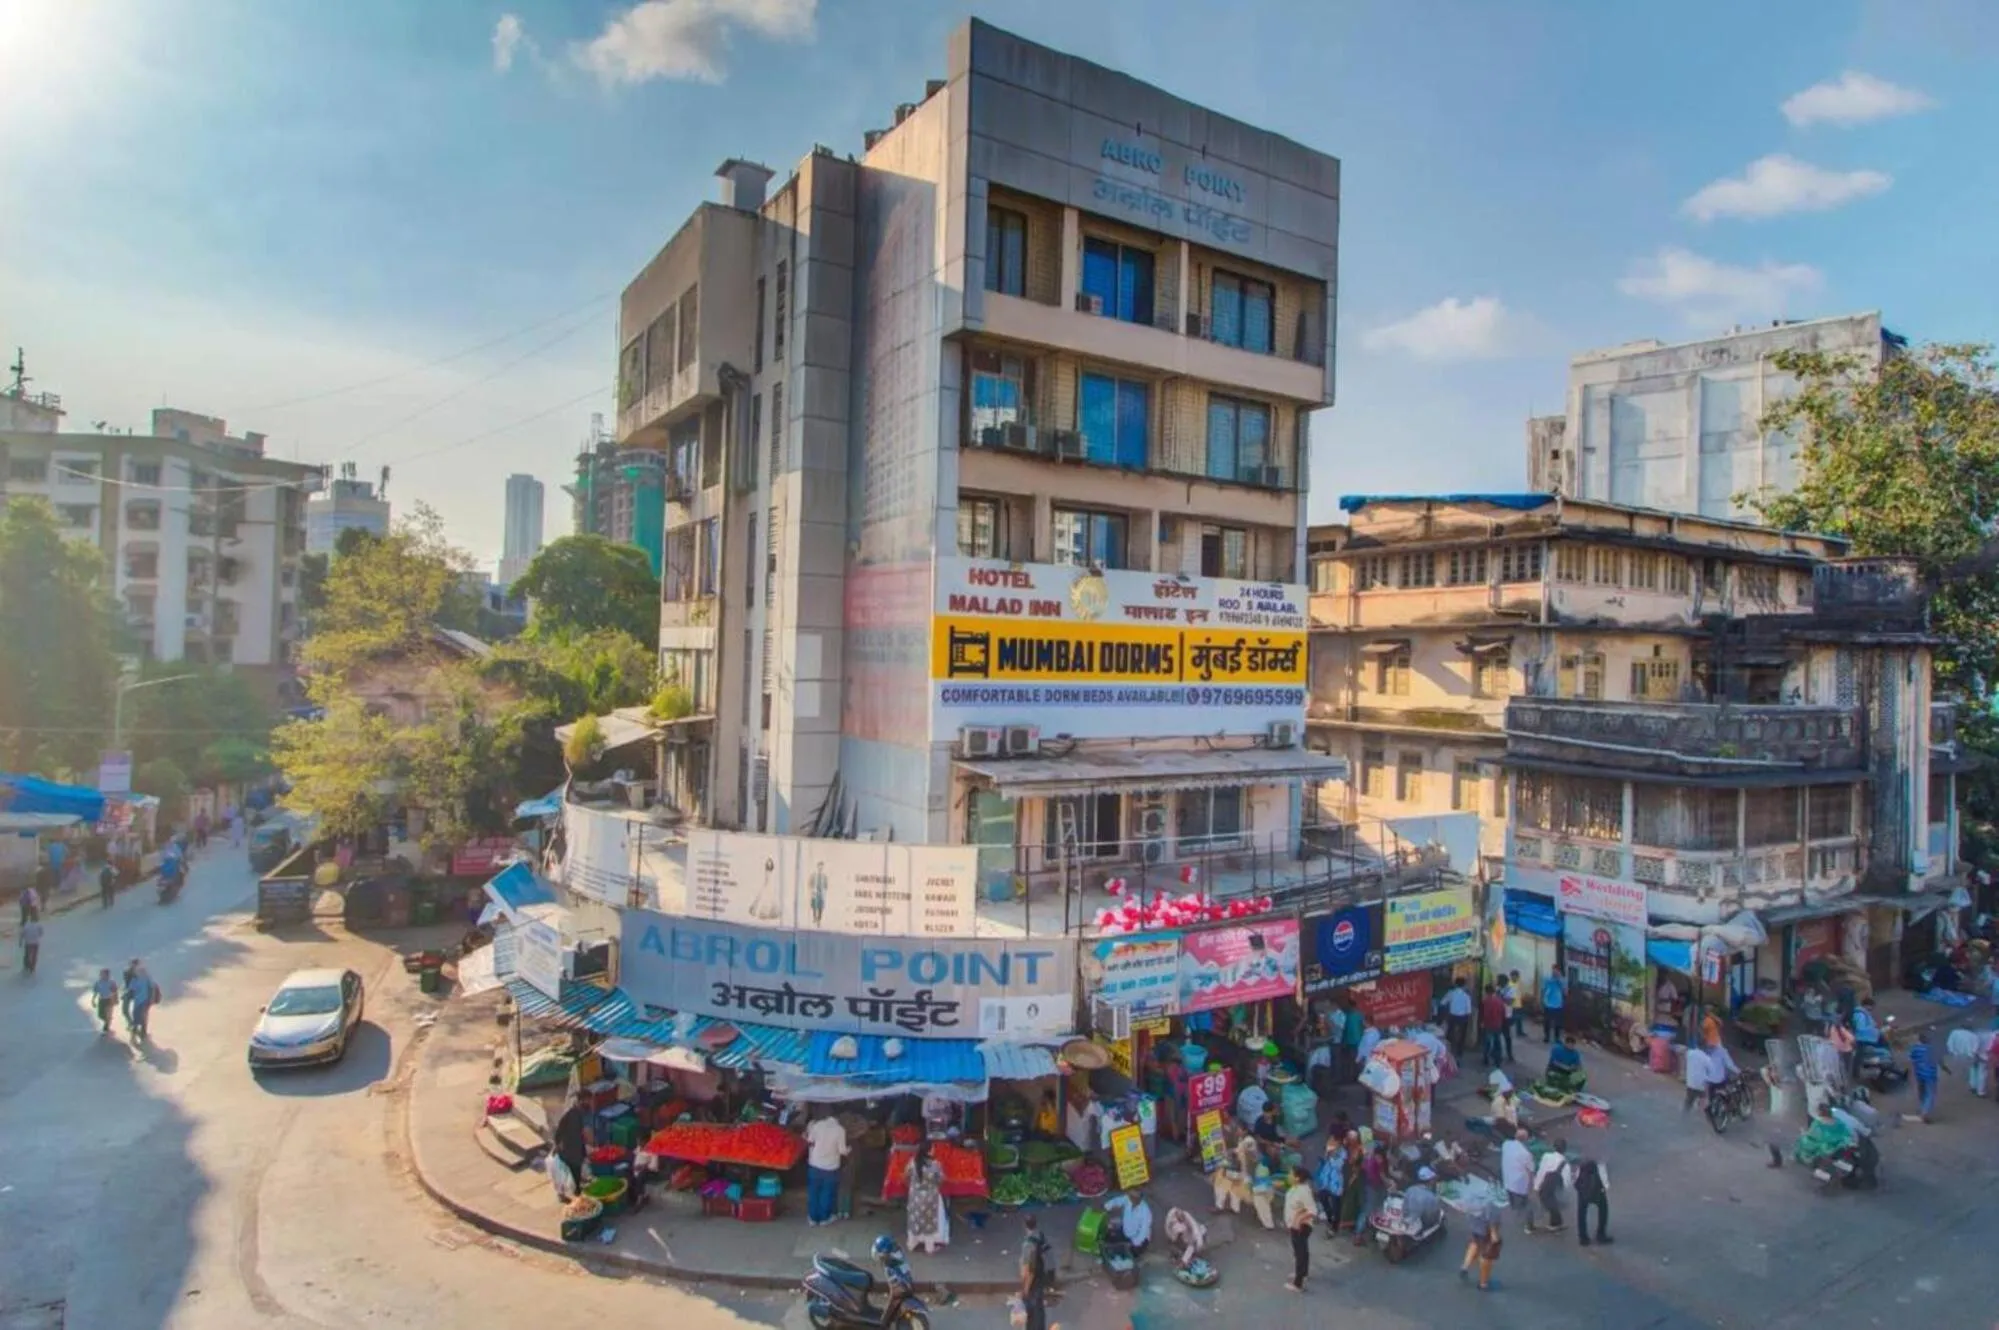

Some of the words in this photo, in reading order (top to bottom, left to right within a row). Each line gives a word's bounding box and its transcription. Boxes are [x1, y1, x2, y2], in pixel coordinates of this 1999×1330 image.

[1184, 163, 1246, 203] POINT
[969, 567, 1036, 589] HOTEL
[1240, 587, 1250, 598] 24
[1252, 588, 1284, 600] HOURS
[949, 594, 1023, 615] MALAD
[1029, 599, 1061, 617] INN
[1184, 608, 1210, 624] इन
[997, 637, 1094, 673] MUMBAI
[1100, 641, 1173, 675] DORMS
[1190, 637, 1247, 681] मुंबई
[941, 687, 1041, 703] COMFORTABLE
[1045, 689, 1080, 703] DORM
[1084, 690, 1113, 703] BEDS
[1202, 687, 1304, 706] 9769695599
[1586, 878, 1643, 902] Wedding
[639, 925, 824, 978] ABROL
[861, 949, 1055, 985] POINT
[711, 981, 836, 1019] अब्रोल
